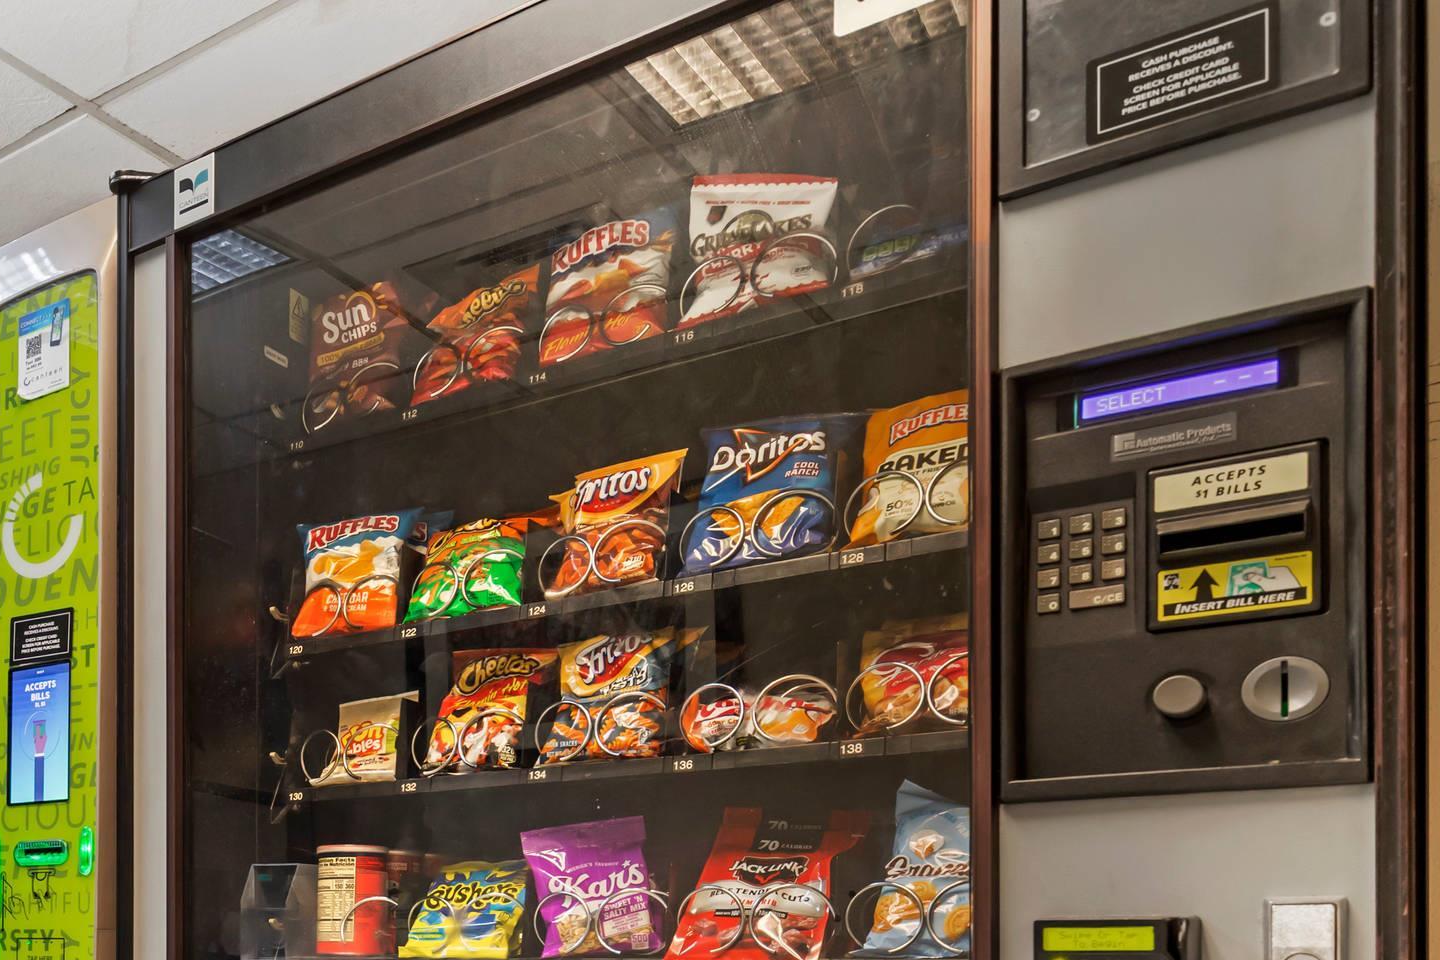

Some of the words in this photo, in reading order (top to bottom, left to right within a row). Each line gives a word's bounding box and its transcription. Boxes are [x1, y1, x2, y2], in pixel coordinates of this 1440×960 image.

[1141, 54, 1167, 68] CASH
[1169, 36, 1220, 58] PURCHASE
[1128, 62, 1172, 82] RECEIVES
[1173, 59, 1181, 67] A
[1182, 41, 1235, 65] DISCOUNT.
[1132, 78, 1165, 94] CHECK
[1166, 65, 1200, 82] CREDIT
[1201, 57, 1230, 71] CARD
[1123, 89, 1160, 106] SCREEN
[1161, 81, 1181, 94] FOR
[1182, 62, 1239, 88] APPLICABLE
[1121, 102, 1148, 115] PRICE
[1149, 89, 1187, 107] BEFORE
[1188, 72, 1242, 96] PURCHASE.
[552, 219, 649, 275] RUFFLES
[841, 284, 864, 297] 118
[322, 303, 370, 344] Sun
[341, 321, 377, 344] CHIPS
[674, 330, 694, 342] 116
[529, 373, 546, 384] 114
[1096, 386, 1167, 413] SELECT
[71, 367, 90, 468] JUICY
[402, 409, 417, 420] 112
[890, 405, 968, 445] RUFFLE
[1136, 429, 1185, 448] Automatic
[1187, 422, 1232, 439] Products
[710, 432, 826, 472] Doritos
[793, 461, 819, 469] COOL
[785, 468, 819, 478] RANCH
[1192, 465, 1266, 486] ACCEPTS
[1195, 489, 1208, 498] $1
[1216, 480, 1262, 497] BILLS
[1081, 522, 1091, 531] 2
[1114, 516, 1123, 526] 3
[308, 514, 399, 552] RUFFLES
[1051, 527, 1058, 536] 1
[1081, 547, 1090, 556] 5
[1114, 542, 1123, 551] 6
[841, 552, 864, 564] 128
[1049, 552, 1058, 560] 4
[1049, 576, 1058, 585] 7
[1081, 572, 1090, 581] 8
[674, 582, 694, 594] 126
[1093, 592, 1123, 604] C/CE
[1174, 599, 1225, 615] INSERT
[1226, 595, 1257, 608] BILL
[1258, 590, 1296, 605] HERE
[529, 605, 545, 616] 124
[401, 628, 416, 638] 122
[289, 645, 303, 655] 120
[25, 680, 57, 692] ACCEPTS
[31, 691, 50, 702] BILLS
[841, 743, 863, 755] 138
[673, 760, 693, 771] 136
[529, 769, 546, 780] 134
[401, 782, 416, 793] 132
[289, 792, 303, 801] 130
[758, 839, 780, 851] 70
[729, 860, 767, 875] JACK
[781, 892, 811, 902] CUTS
[603, 908, 629, 920] SALTY
[630, 902, 647, 914] MIX
